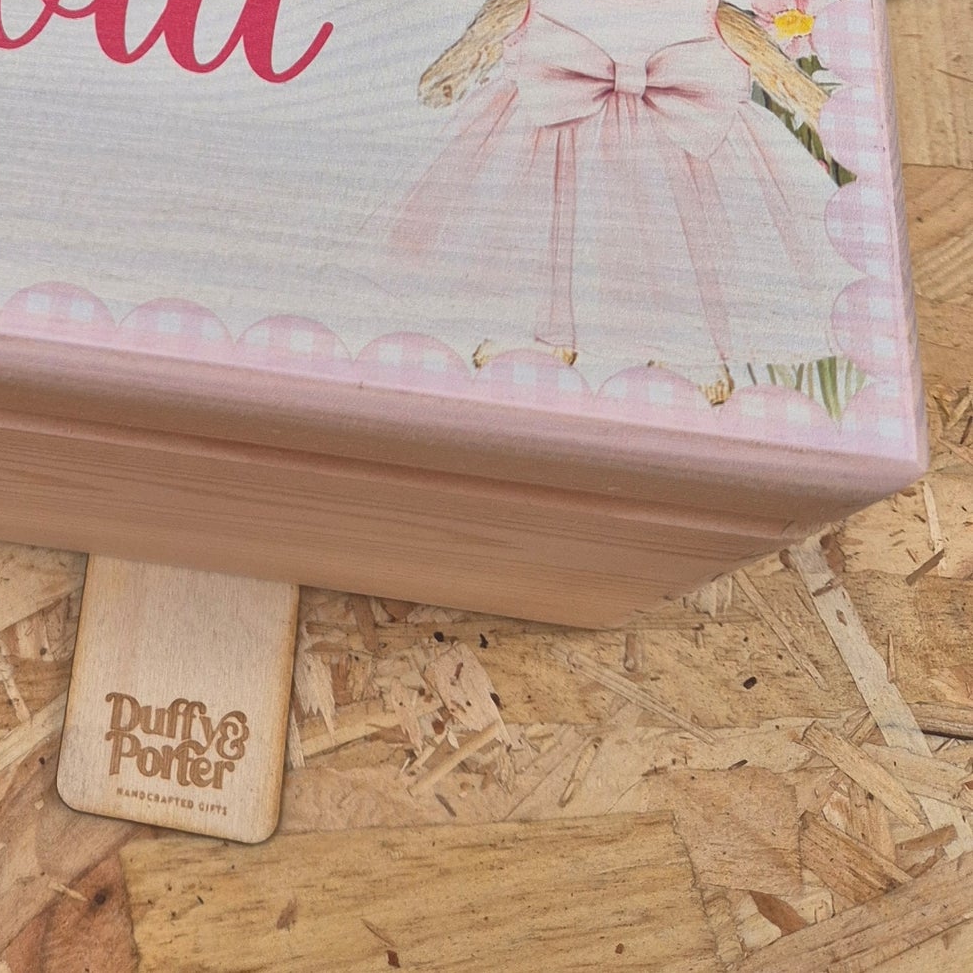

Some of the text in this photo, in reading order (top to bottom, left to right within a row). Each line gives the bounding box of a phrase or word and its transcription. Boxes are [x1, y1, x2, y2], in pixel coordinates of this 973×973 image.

[105, 730, 235, 790] Porter
[116, 787, 228, 817] HANDCRAFTED GIFTS
